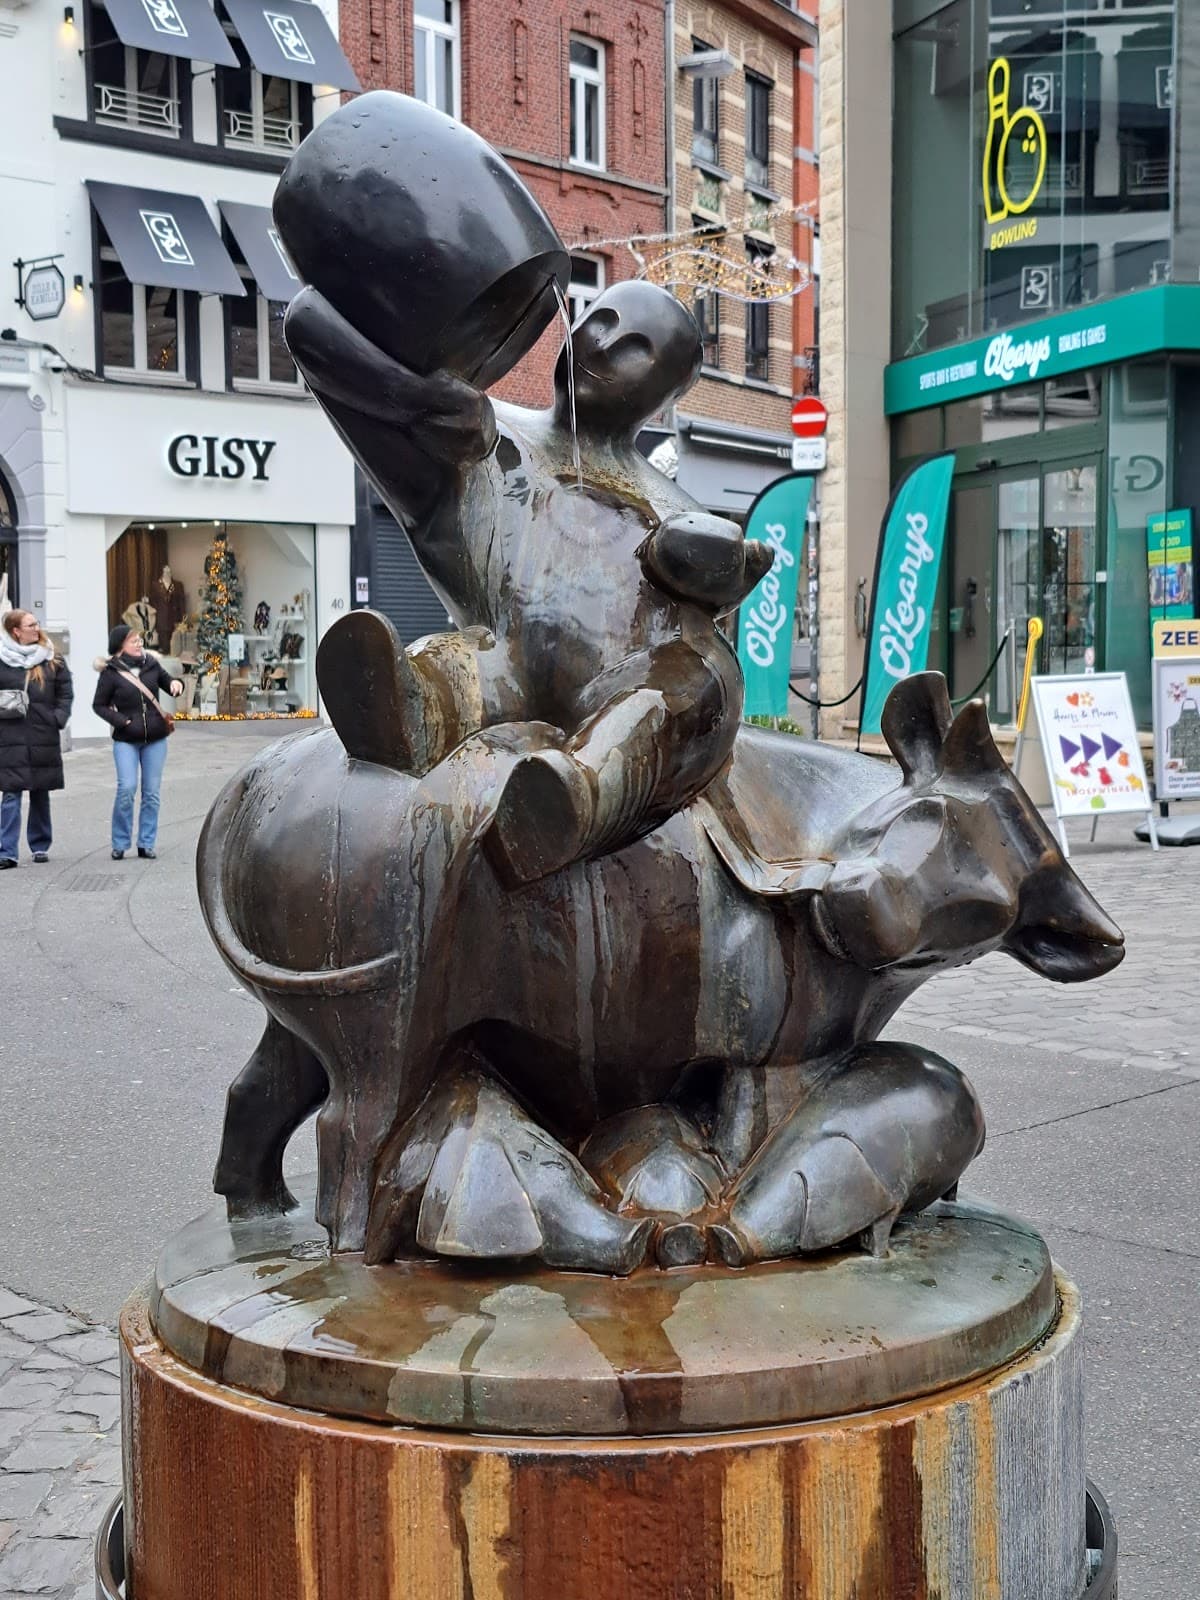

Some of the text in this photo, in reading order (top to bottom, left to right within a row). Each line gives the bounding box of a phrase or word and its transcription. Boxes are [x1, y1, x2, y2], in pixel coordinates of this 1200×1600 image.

[990, 217, 1038, 250] BOWLING
[168, 434, 276, 481] GISY
[331, 598, 345, 609] 40
[880, 512, 934, 680] O'Learys
